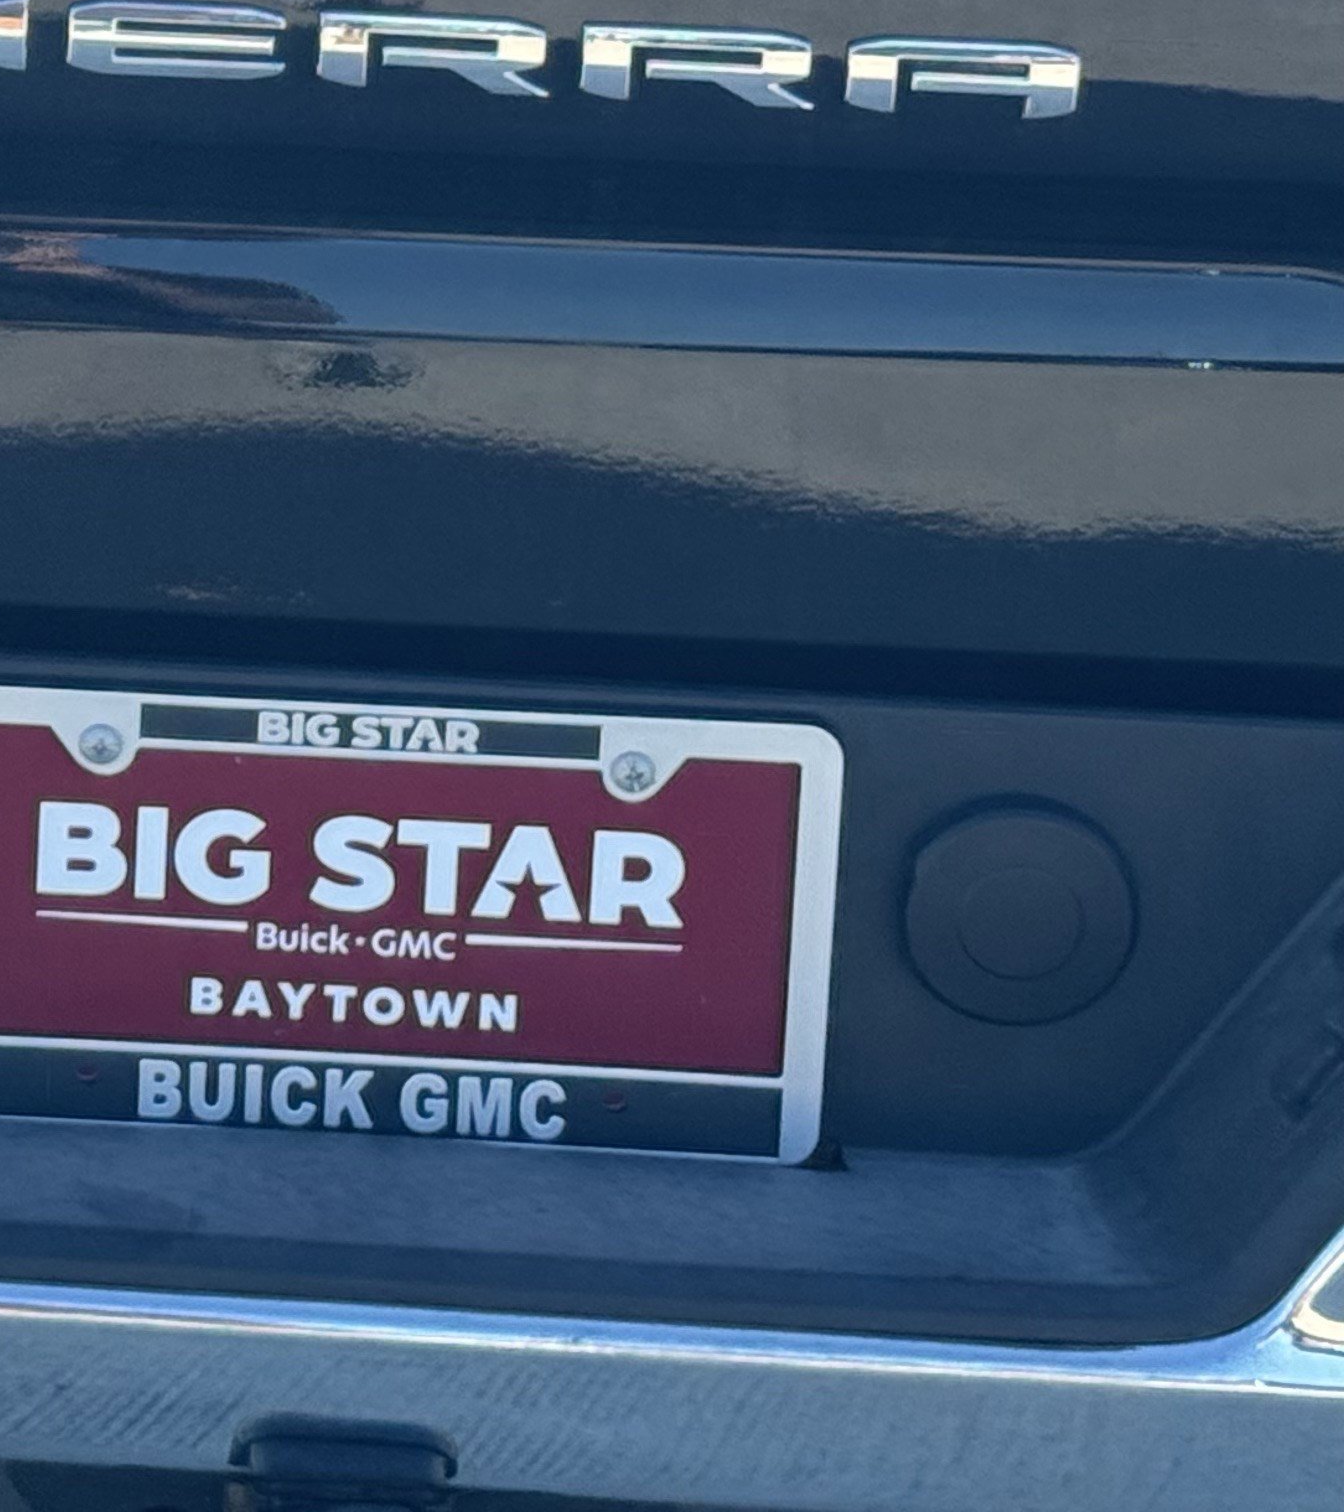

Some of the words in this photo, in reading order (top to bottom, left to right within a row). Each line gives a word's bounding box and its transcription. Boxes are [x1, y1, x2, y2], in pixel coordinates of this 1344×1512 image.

[257, 711, 340, 747] BIG
[350, 715, 479, 754] STAR
[35, 800, 272, 906] BIG
[309, 815, 686, 929] STAR
[255, 922, 350, 957] Buick
[371, 928, 458, 961] GMC
[189, 977, 519, 1033] BAYTOWN
[136, 1058, 374, 1130] BUICK
[399, 1074, 567, 1141] GMC
